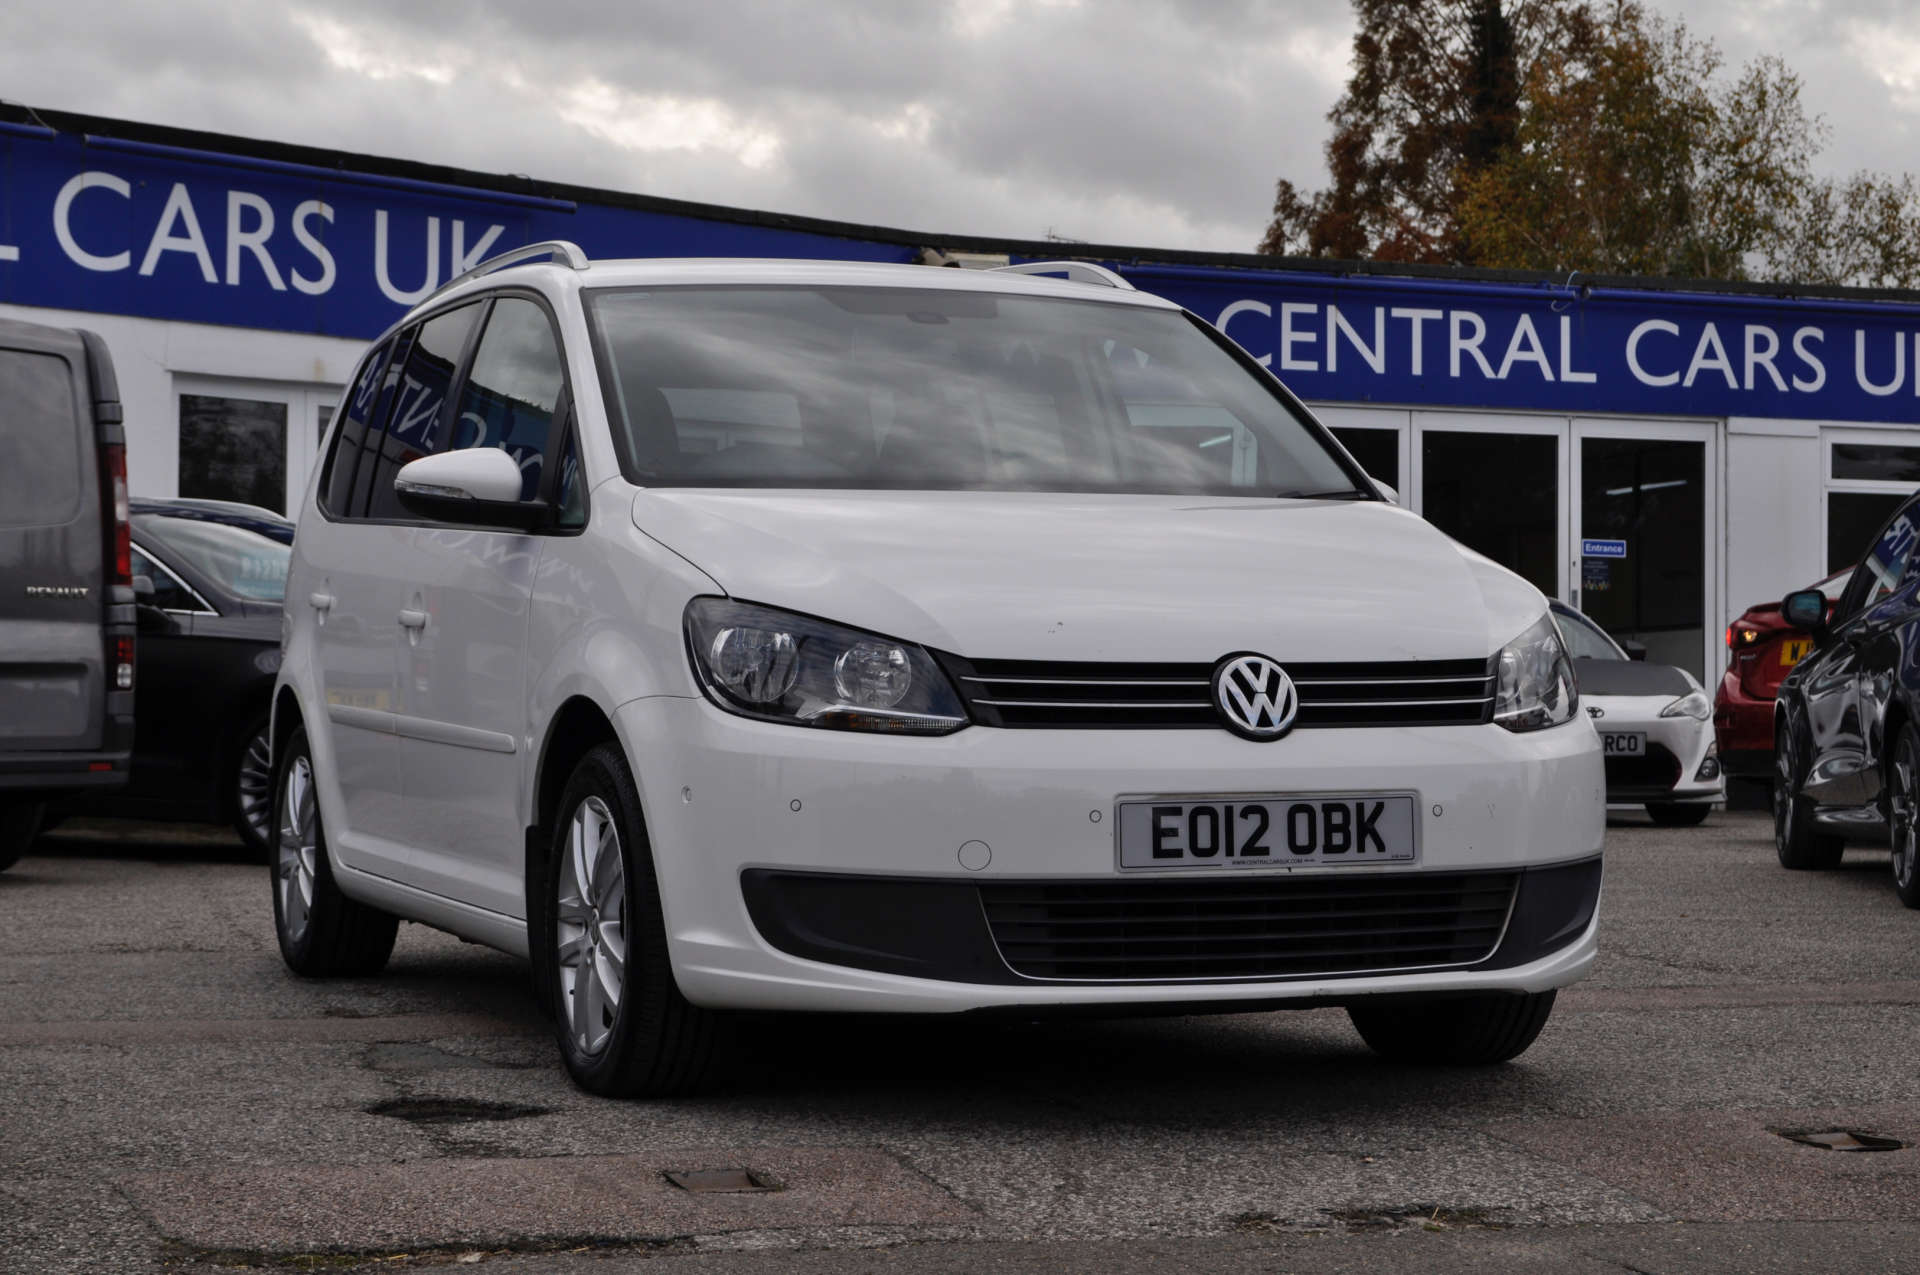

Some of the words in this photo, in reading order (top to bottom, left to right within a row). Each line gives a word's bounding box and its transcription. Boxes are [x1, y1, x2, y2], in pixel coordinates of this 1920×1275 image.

[53, 171, 337, 296] CARS
[1215, 299, 1597, 384] CENTRAL
[1625, 318, 1827, 394] CARS
[1855, 329, 1920, 397] U
[1585, 543, 1623, 553] Entrance
[1221, 659, 1294, 731] VW
[1152, 804, 1271, 859] EO12
[1286, 801, 1387, 855] OBK
